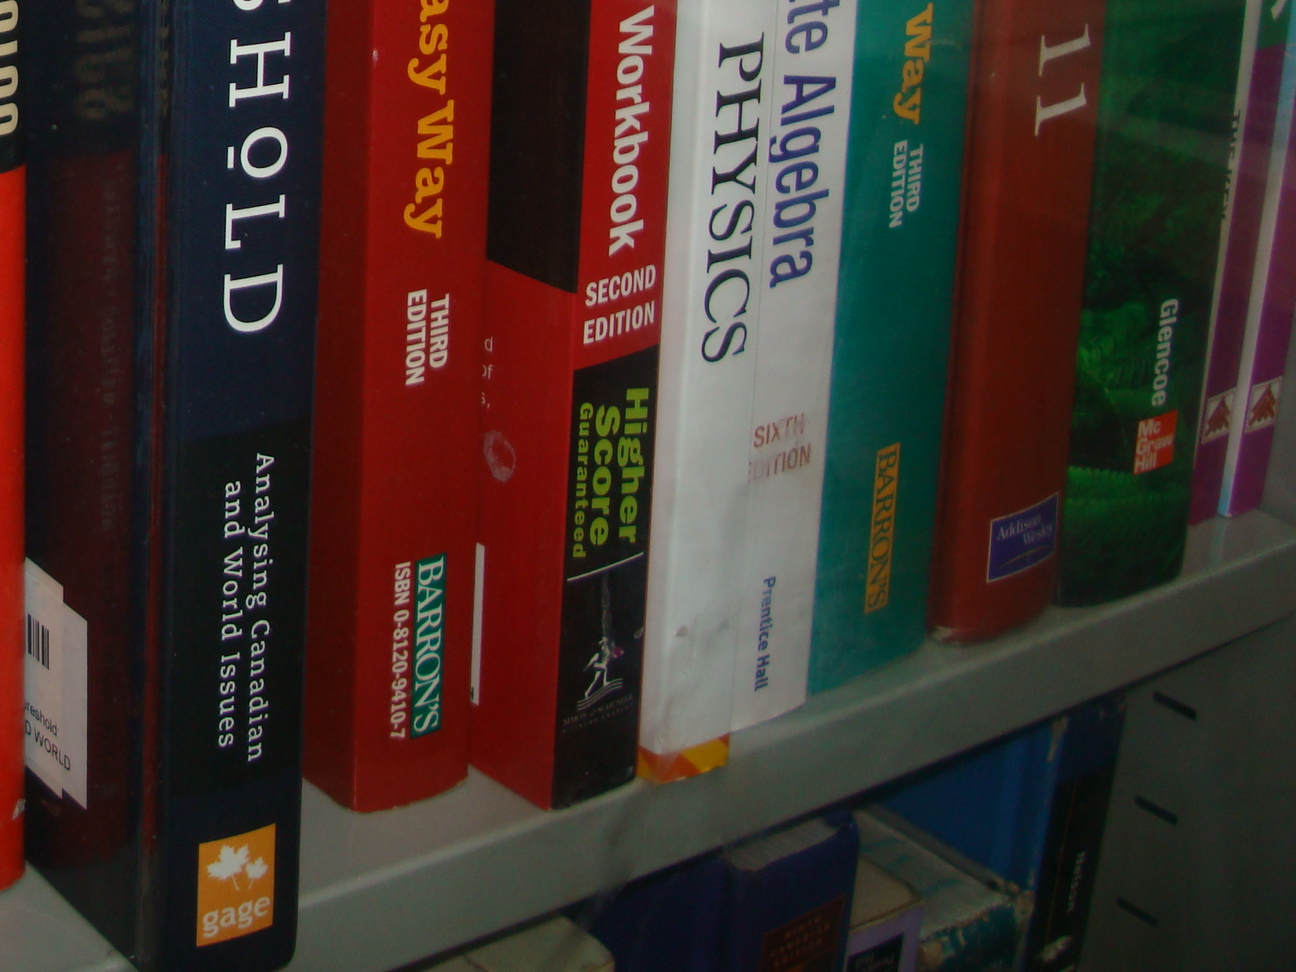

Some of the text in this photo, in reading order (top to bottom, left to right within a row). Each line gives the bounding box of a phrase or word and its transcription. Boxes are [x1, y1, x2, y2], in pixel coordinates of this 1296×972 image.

[893, 2, 933, 125] Way
[1034, 23, 1091, 136] 11
[403, 98, 456, 238] Way
[608, 4, 654, 256] Workbook
[768, 74, 837, 288] Algebra
[889, 140, 908, 228] EDITION
[906, 143, 923, 212] THIRD
[701, 31, 765, 363] PHYSICS
[405, 288, 427, 386] EDITION
[429, 293, 450, 369] THIRD
[583, 300, 655, 344] EDITION
[585, 263, 657, 307] SECOND
[1151, 298, 1179, 407] Glencoe
[572, 402, 594, 558] Guaranteed
[590, 405, 620, 546] Score
[617, 387, 649, 543] Higher
[1135, 452, 1157, 473] Hill
[1136, 432, 1174, 455] Graw
[1138, 420, 1161, 437] Mc
[394, 561, 411, 604] ISBN
[867, 448, 898, 608] BARRON'S
[218, 480, 245, 748] and World Issues
[246, 452, 275, 762] Analysing Canadian
[415, 555, 445, 734] BARRON'S
[754, 575, 776, 691] Prentice Hall
[34, 730, 71, 771] WORLD
[202, 893, 271, 938] gage
